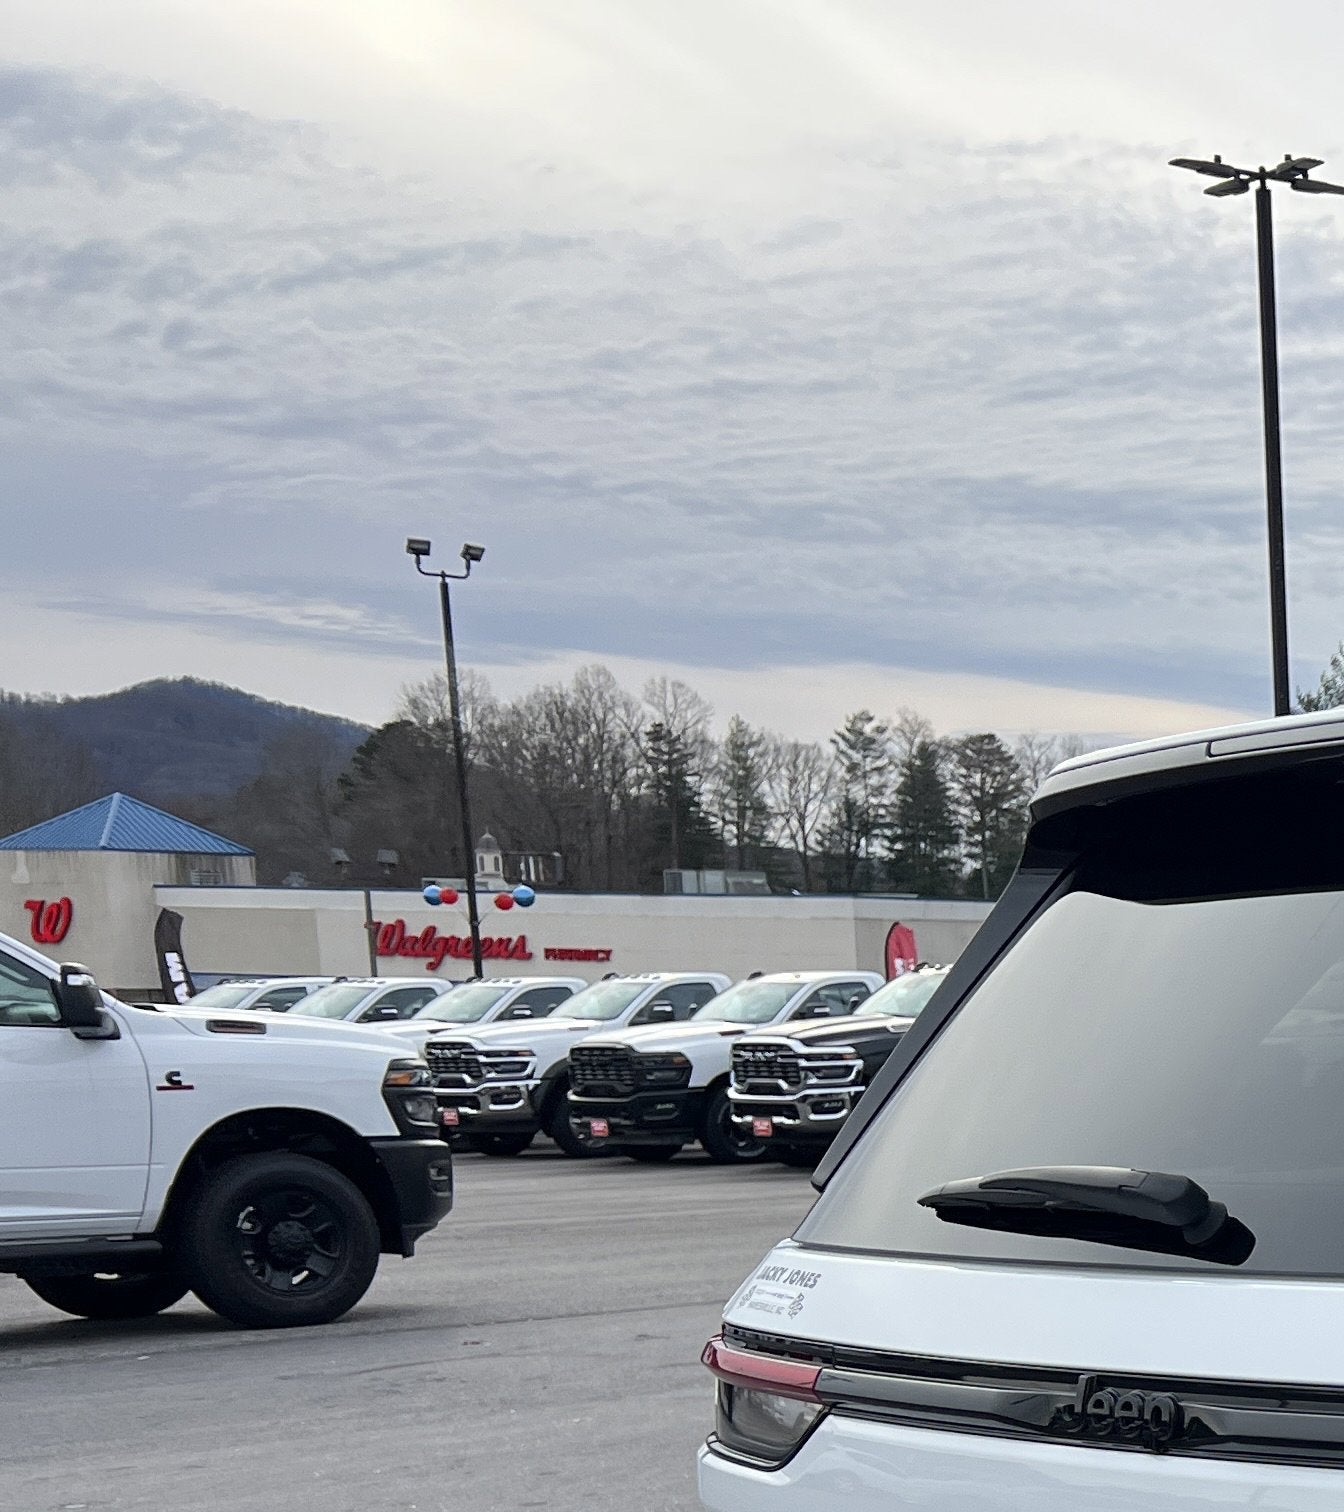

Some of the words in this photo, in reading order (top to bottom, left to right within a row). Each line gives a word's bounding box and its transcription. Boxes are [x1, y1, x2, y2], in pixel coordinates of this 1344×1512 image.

[24, 897, 72, 944] W
[364, 918, 533, 971] Walgreens
[782, 1269, 822, 1289] JONES
